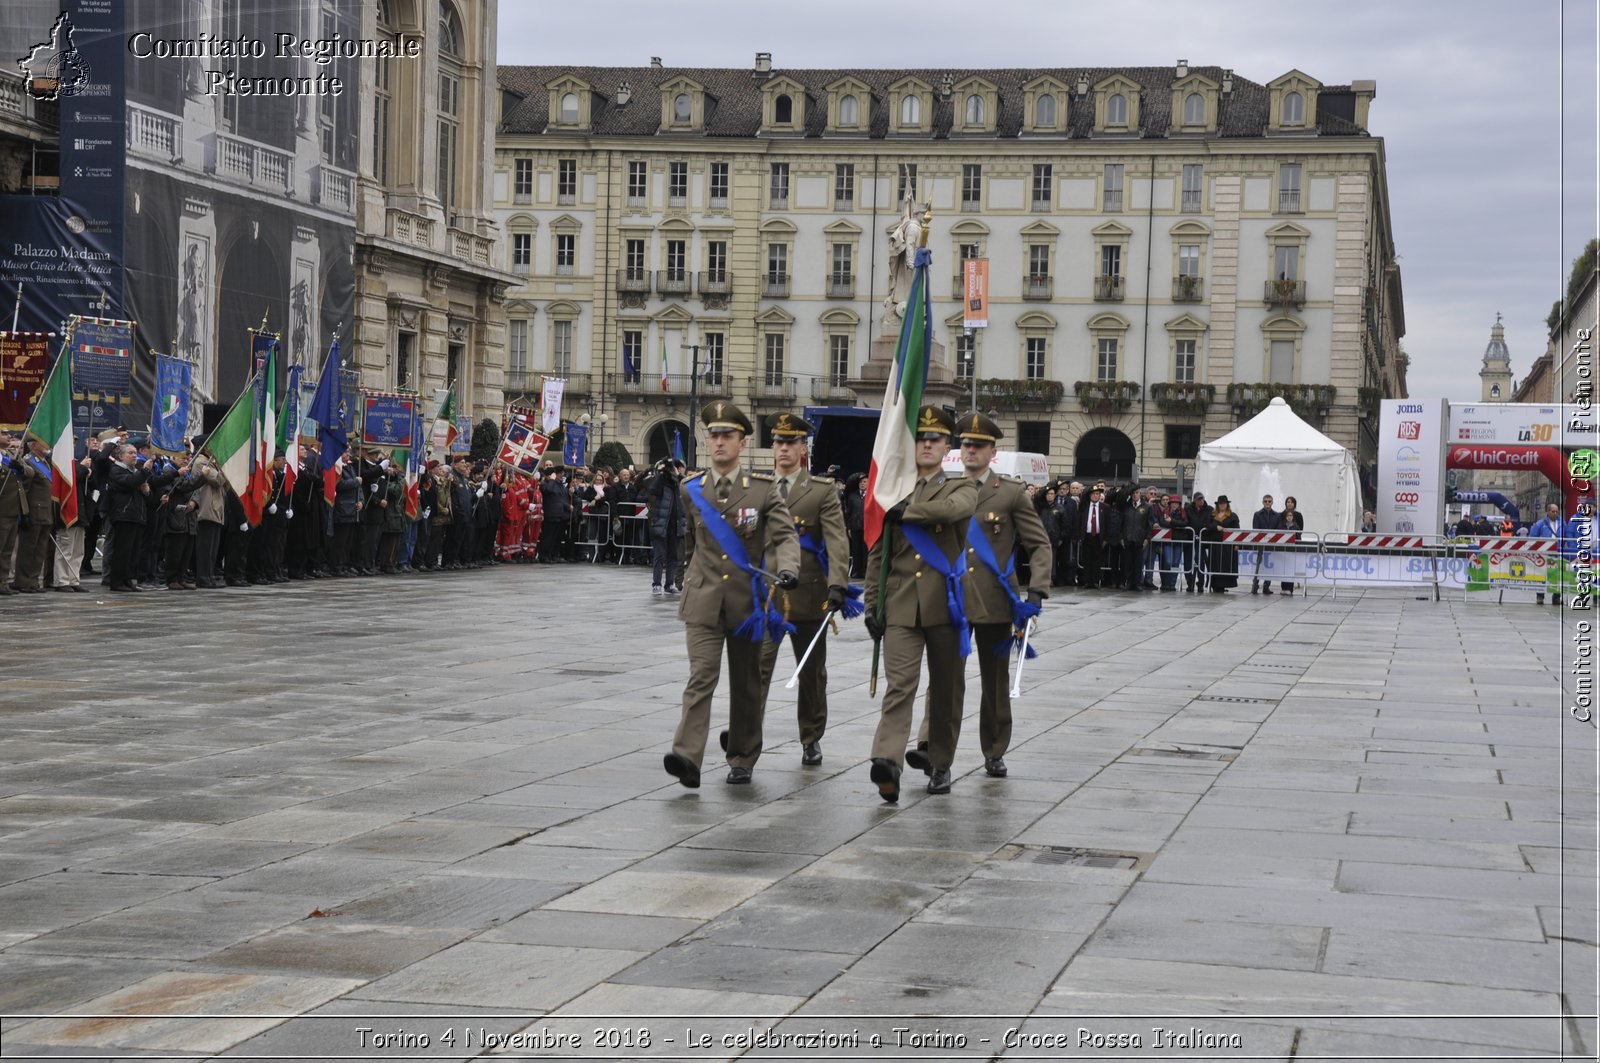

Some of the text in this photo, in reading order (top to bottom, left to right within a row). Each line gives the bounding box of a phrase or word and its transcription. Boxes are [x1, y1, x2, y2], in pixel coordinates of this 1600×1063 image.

[14, 243, 111, 261] Palazzo Madama
[0, 259, 112, 275] Museo Civico d'Arte Antica
[36, 275, 79, 285] Rinascimento
[85, 277, 112, 287] Barocco
[1401, 422, 1416, 437] RDS
[1473, 450, 1539, 465] UniCredit
[1395, 492, 1419, 505] coop
